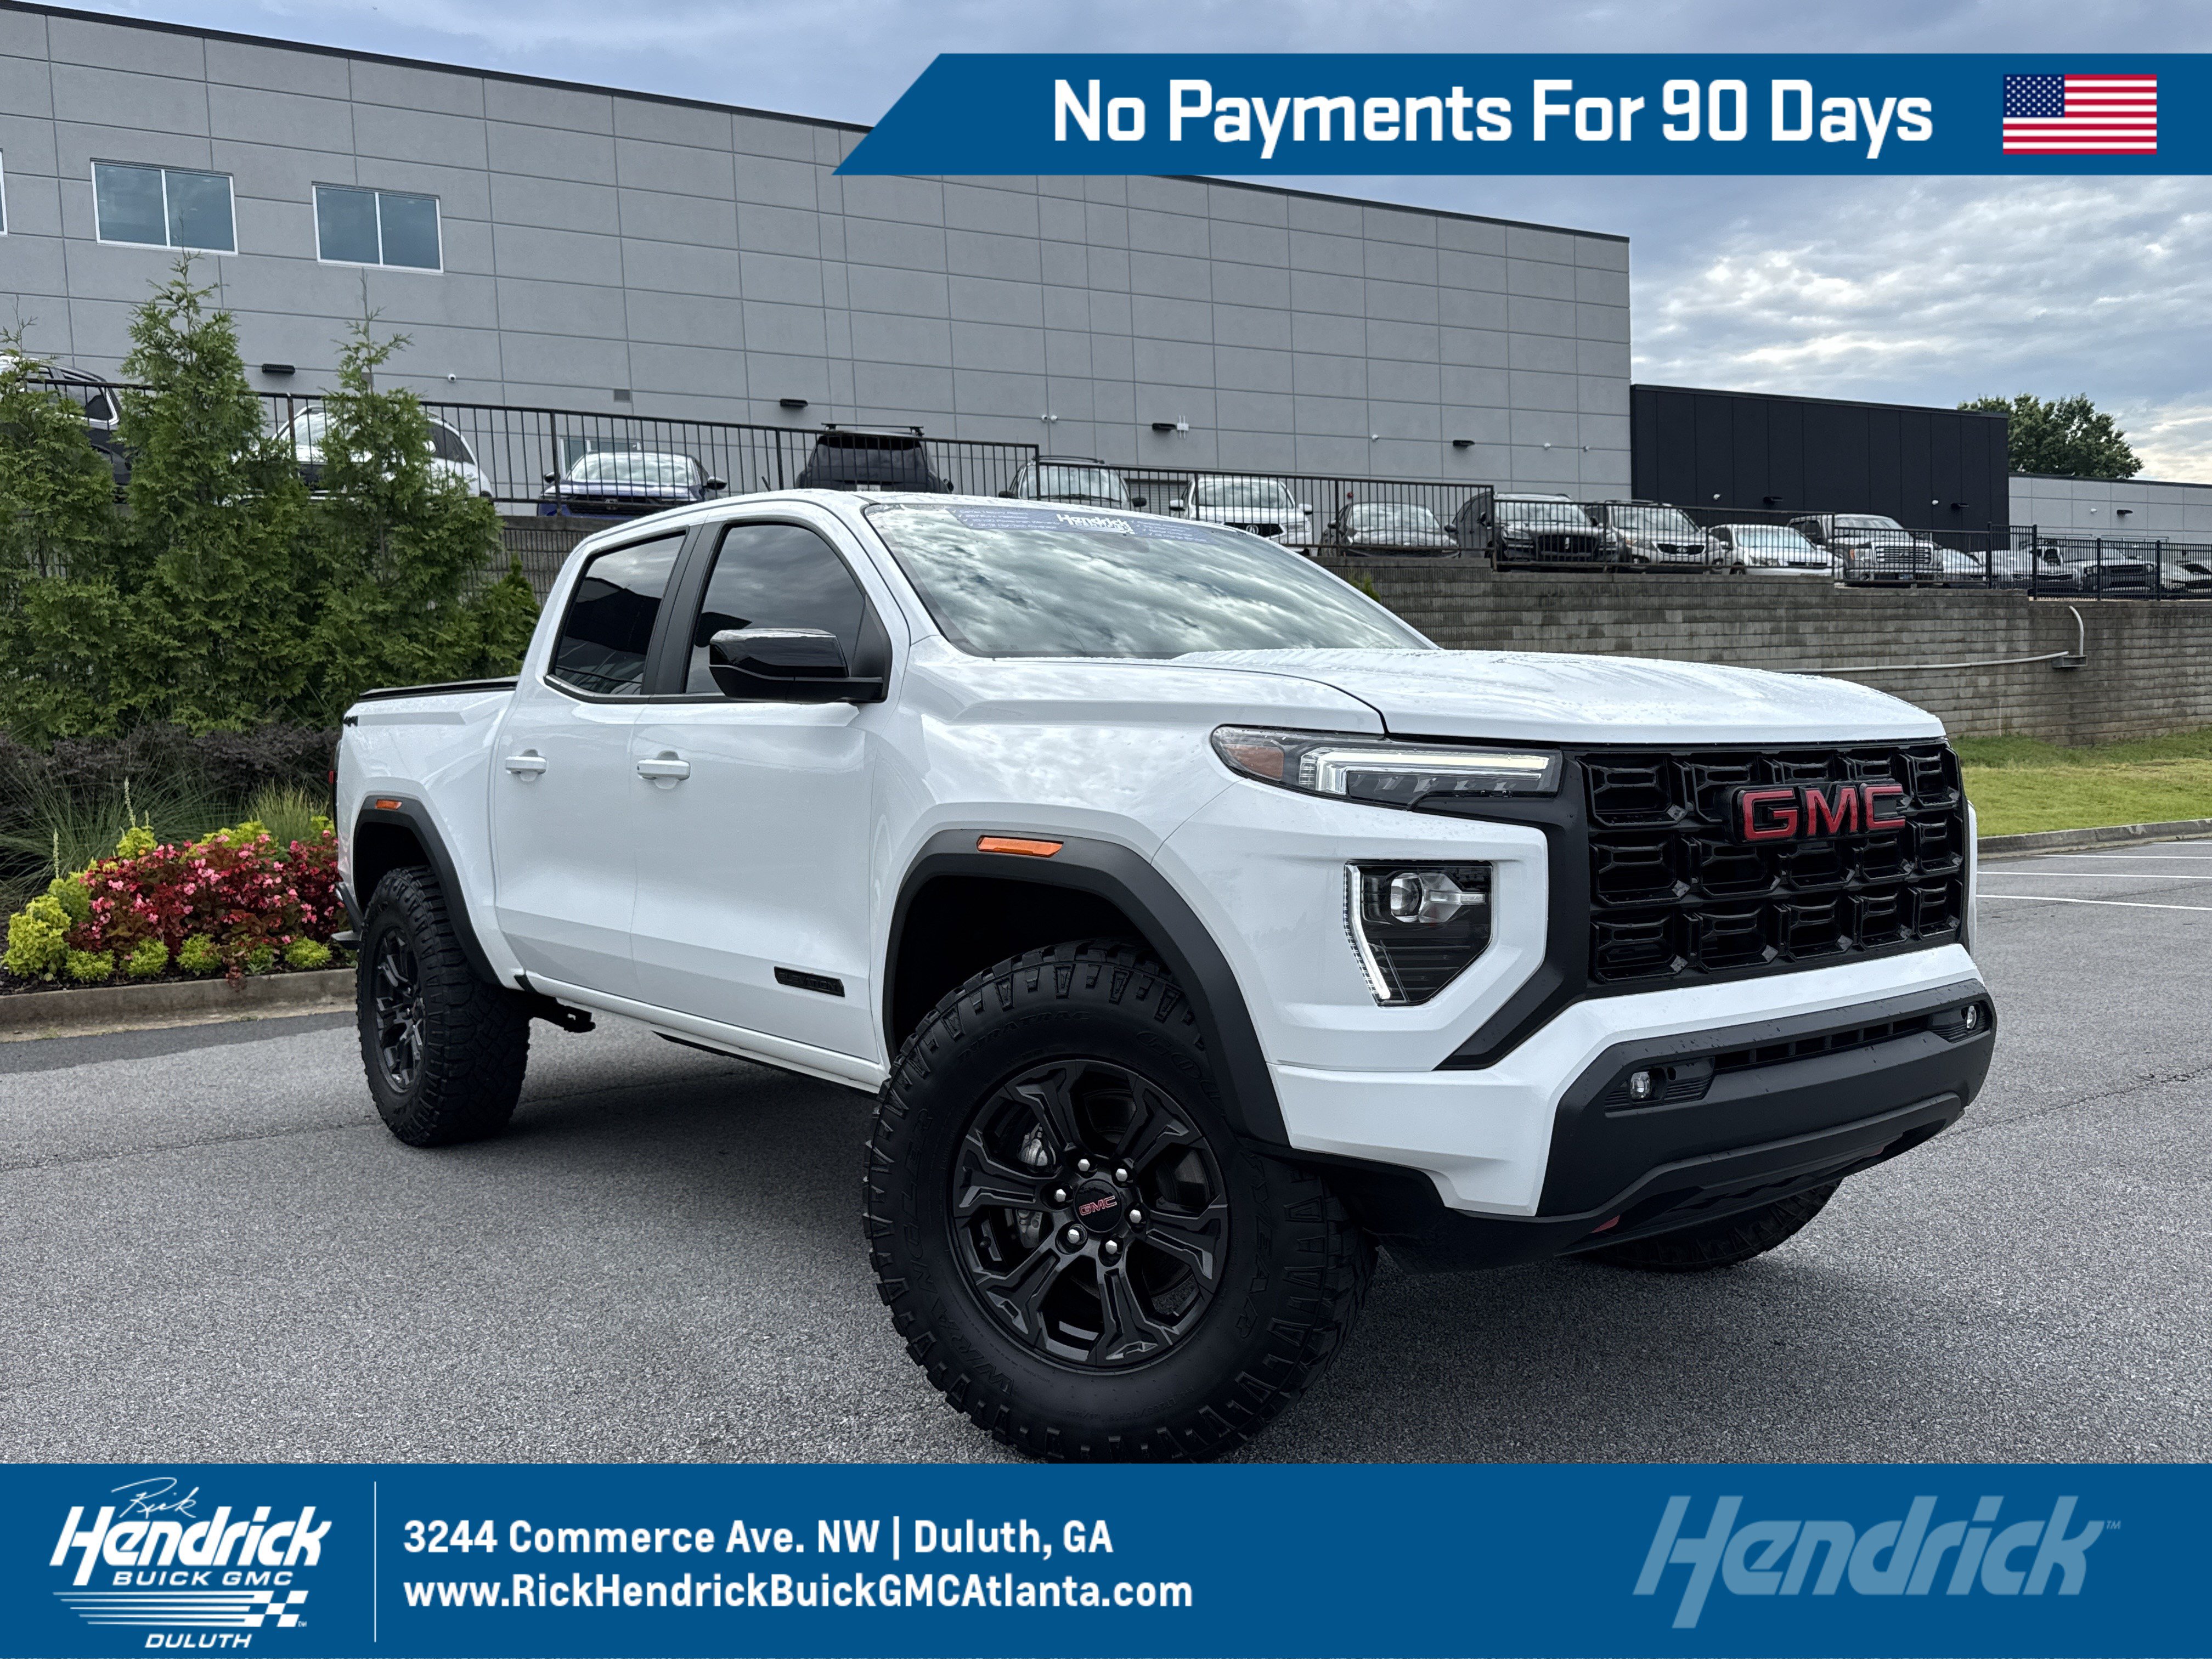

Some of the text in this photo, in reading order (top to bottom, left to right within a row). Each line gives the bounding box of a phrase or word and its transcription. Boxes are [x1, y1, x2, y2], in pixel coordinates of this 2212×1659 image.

[1742, 785, 1905, 840] GMC
[1079, 1195, 1118, 1216] GMC
[902, 1108, 1015, 1397] WRANGLER
